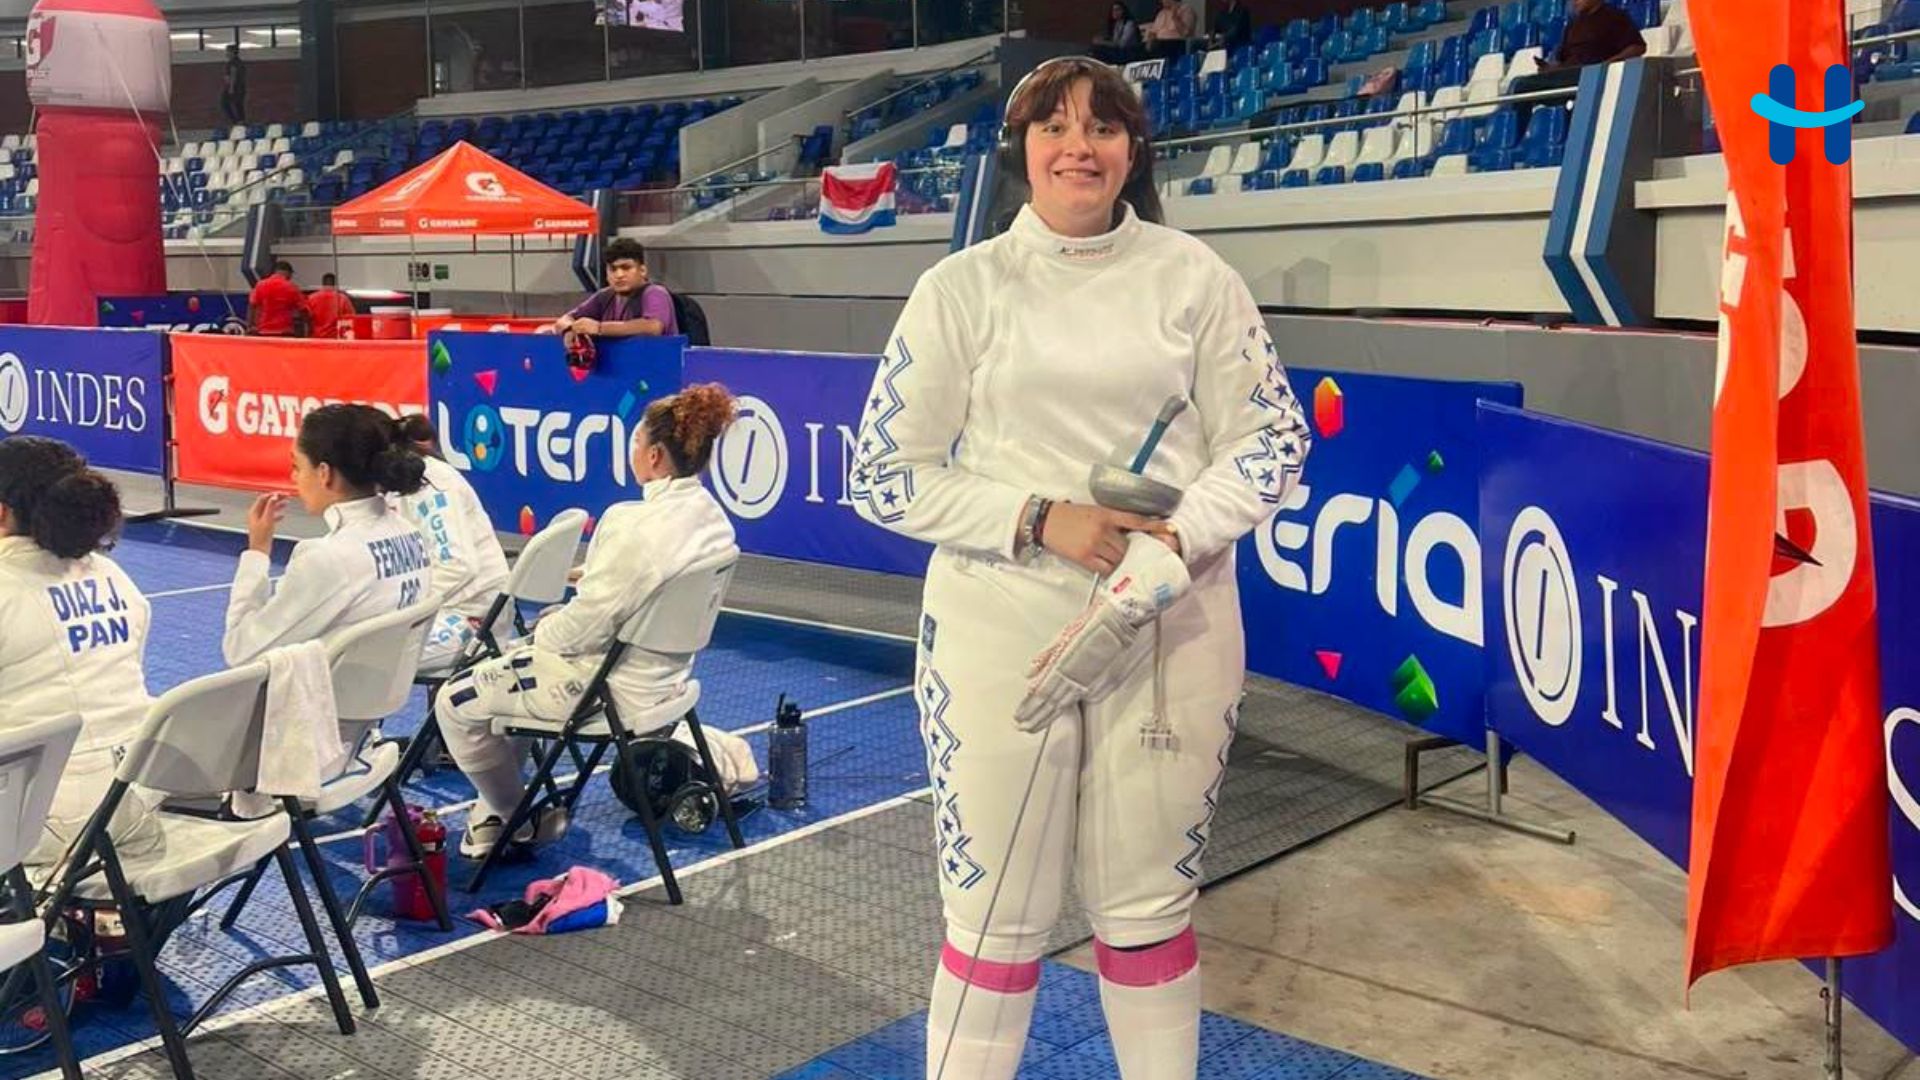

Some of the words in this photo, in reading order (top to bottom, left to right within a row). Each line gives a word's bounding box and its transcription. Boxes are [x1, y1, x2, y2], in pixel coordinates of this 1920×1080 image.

[34, 369, 146, 432] INDES
[48, 579, 106, 622] DIAZ
[106, 576, 128, 611] J.
[68, 616, 129, 653] PAN
